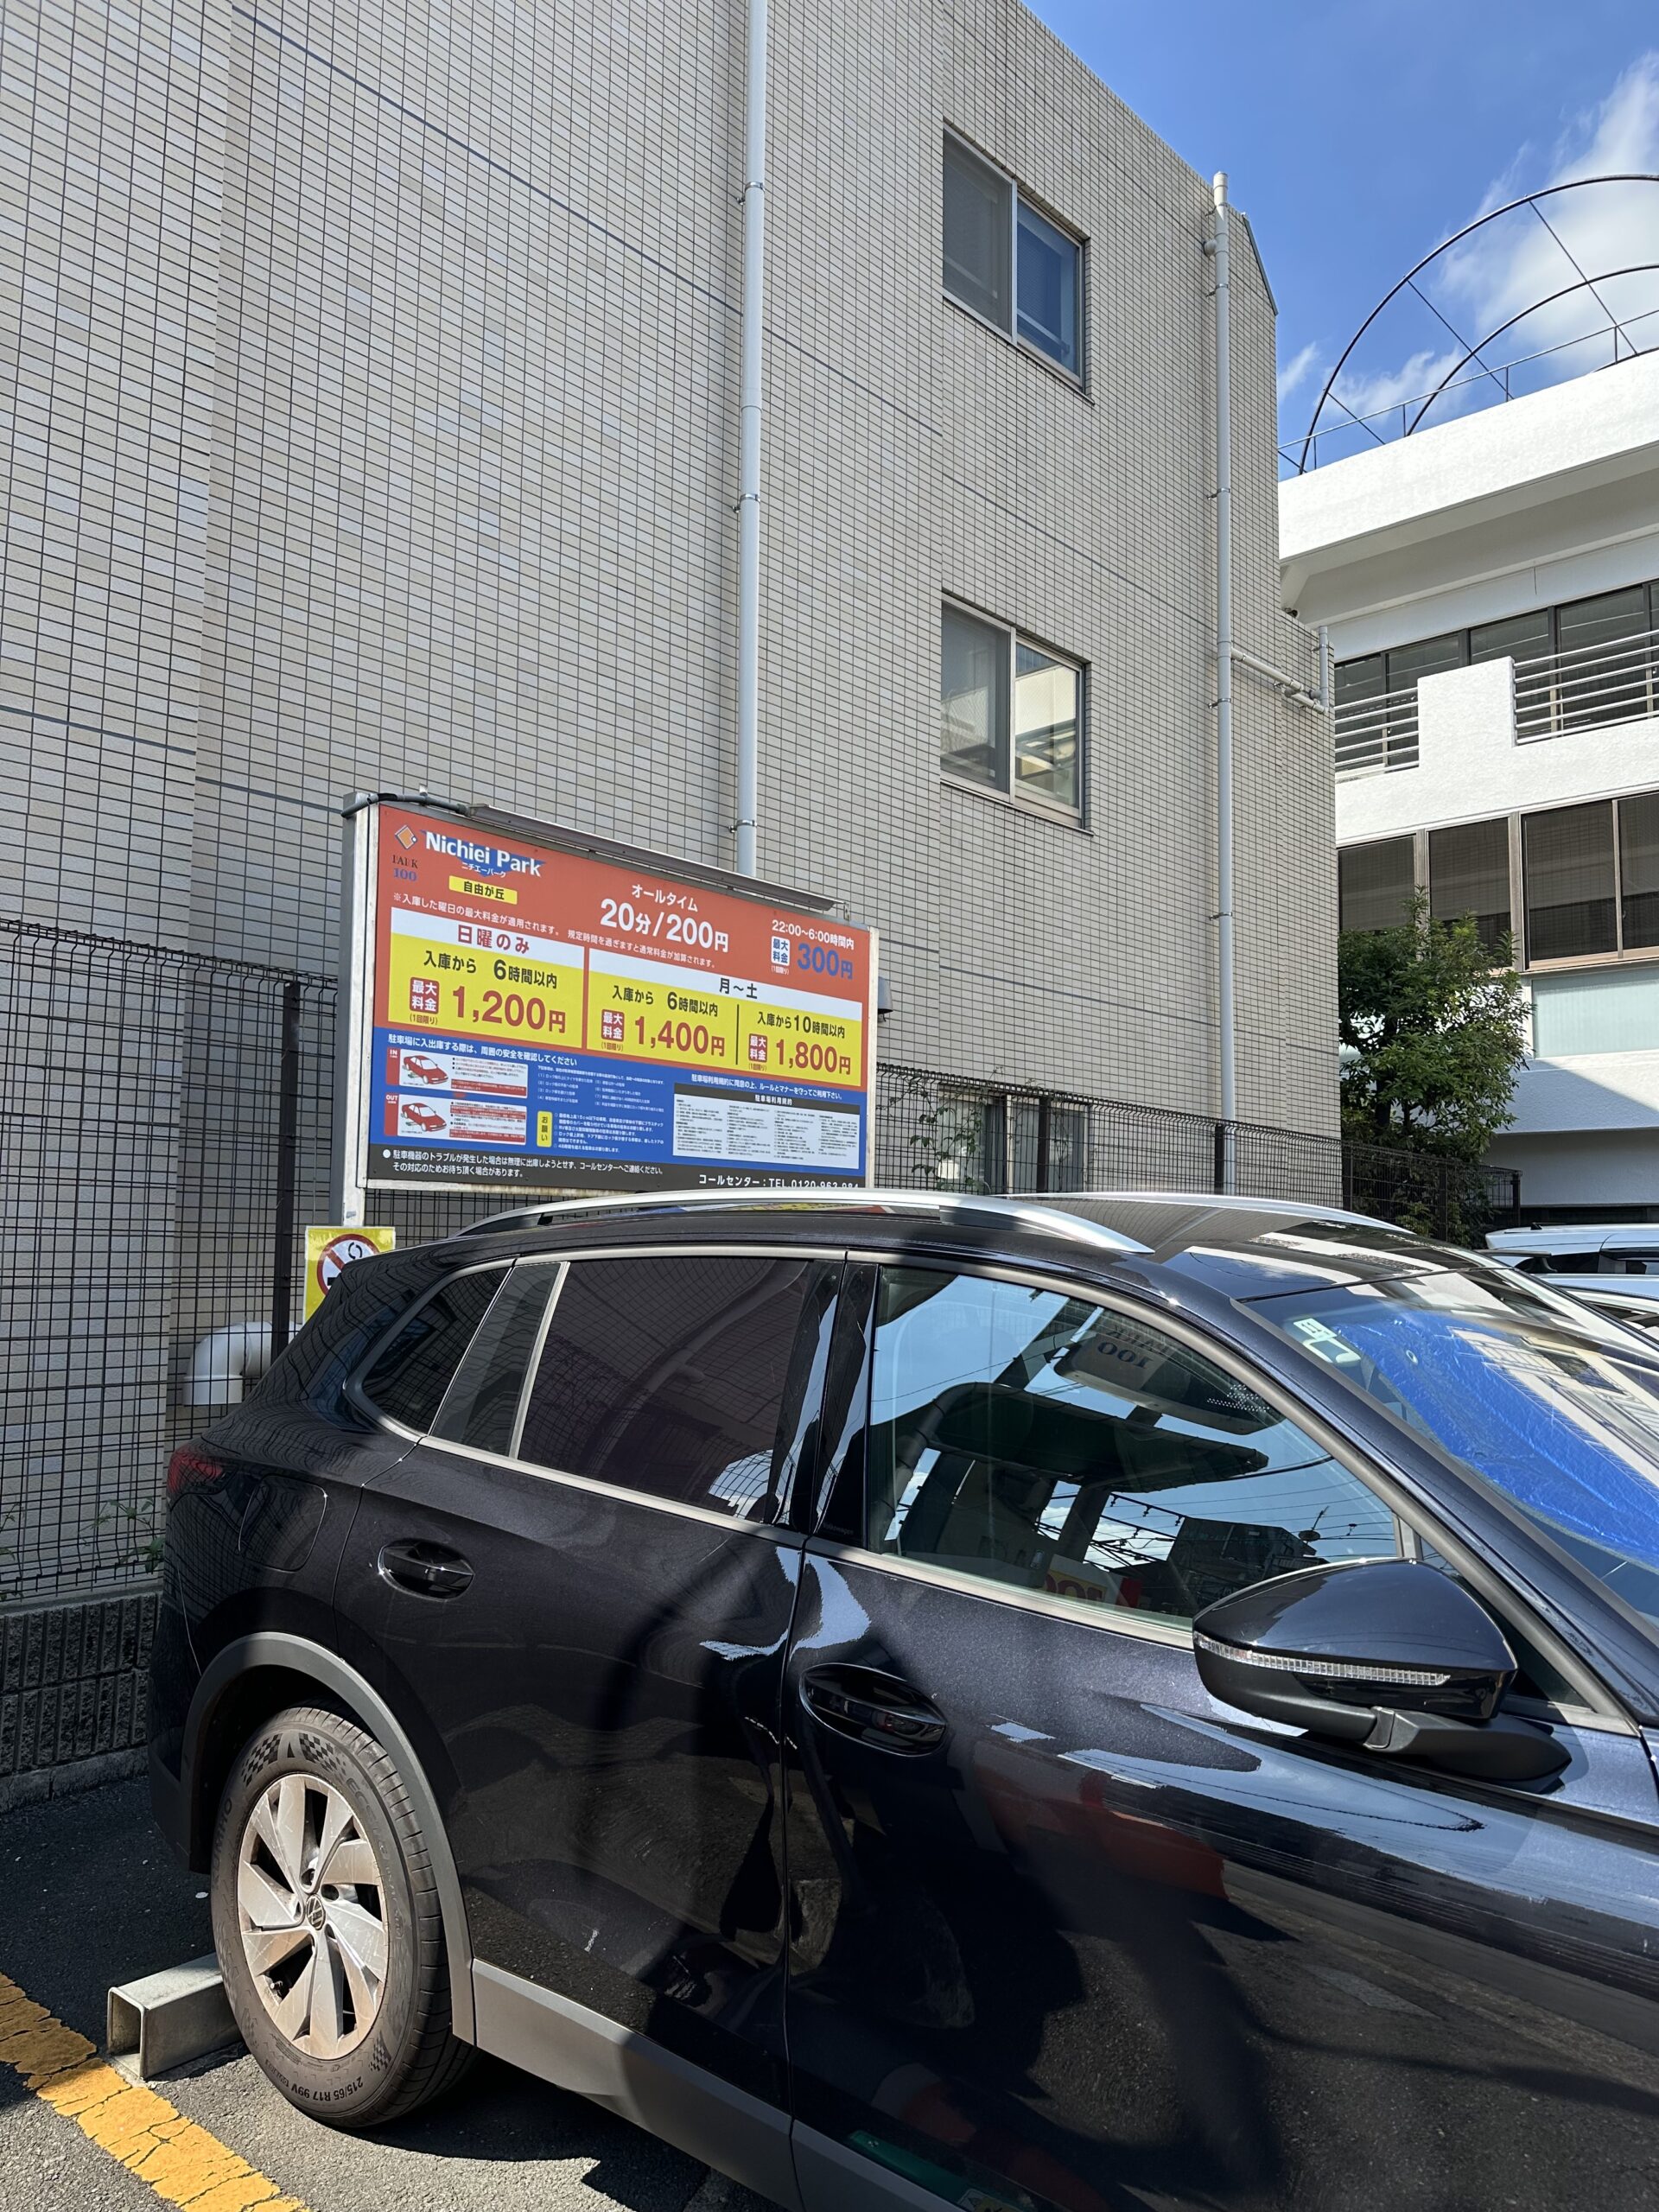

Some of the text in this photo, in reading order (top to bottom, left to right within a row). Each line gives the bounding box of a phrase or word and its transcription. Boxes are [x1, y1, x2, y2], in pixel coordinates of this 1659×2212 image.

[425, 831, 542, 878] Nichiei Park
[393, 868, 417, 881] 100
[463, 880, 505, 900] 自由が丘
[632, 884, 698, 912] オールタイム
[600, 898, 729, 953] 20分/200円
[458, 924, 530, 955] 日曜のみ
[772, 938, 788, 951] 最大
[423, 950, 557, 989] 入庫から 6時間以内
[772, 950, 788, 964] 料金
[797, 942, 854, 980] 300円
[412, 979, 437, 996] 最大
[612, 984, 718, 1017] 入庫から 6時間以内
[411, 995, 437, 1012] 料金
[452, 985, 566, 1034] 1,200円
[602, 1025, 623, 1039] 料金
[603, 1012, 623, 1026] 最大
[634, 1015, 725, 1057] 1,400円
[749, 1036, 766, 1048] 最大
[749, 1048, 766, 1061] 料金
[776, 1039, 851, 1075] 1,800円
[291, 2075, 364, 2101] 215/65 R17 99V
